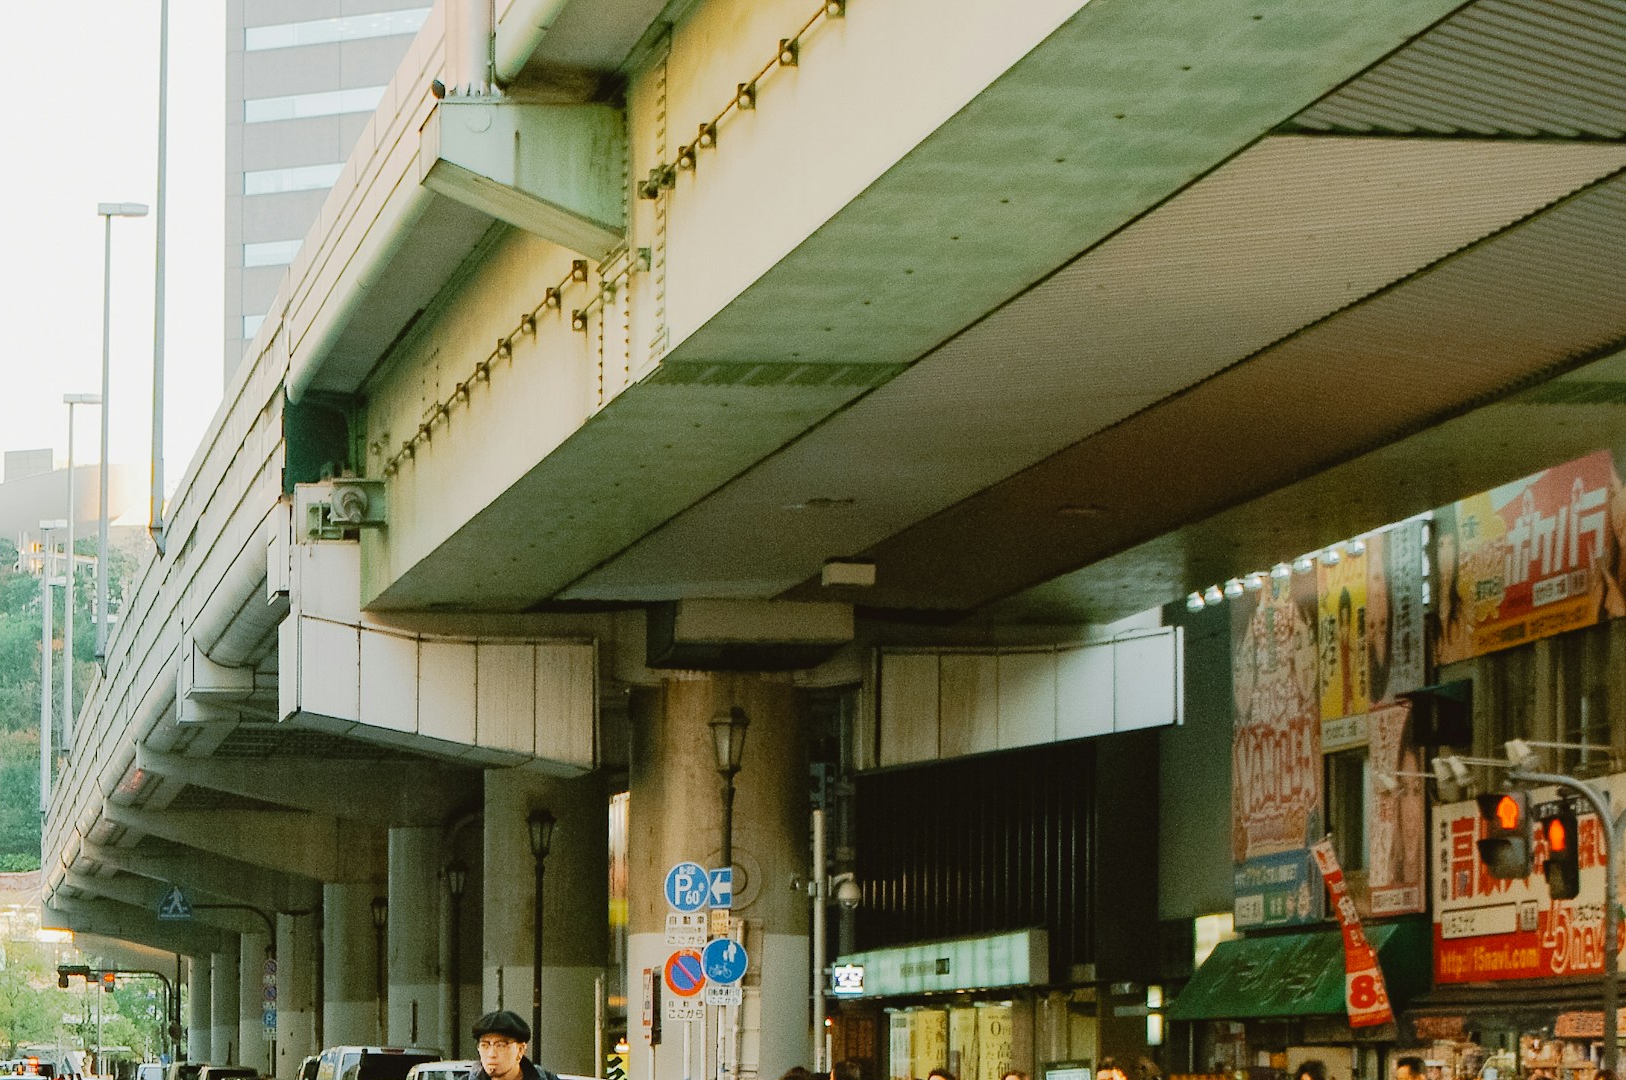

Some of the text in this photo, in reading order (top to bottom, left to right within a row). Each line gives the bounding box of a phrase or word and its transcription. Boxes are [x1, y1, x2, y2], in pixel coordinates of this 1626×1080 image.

[675, 873, 693, 906] P
[667, 935, 705, 945] ここから
[668, 1009, 704, 1019] ここから
